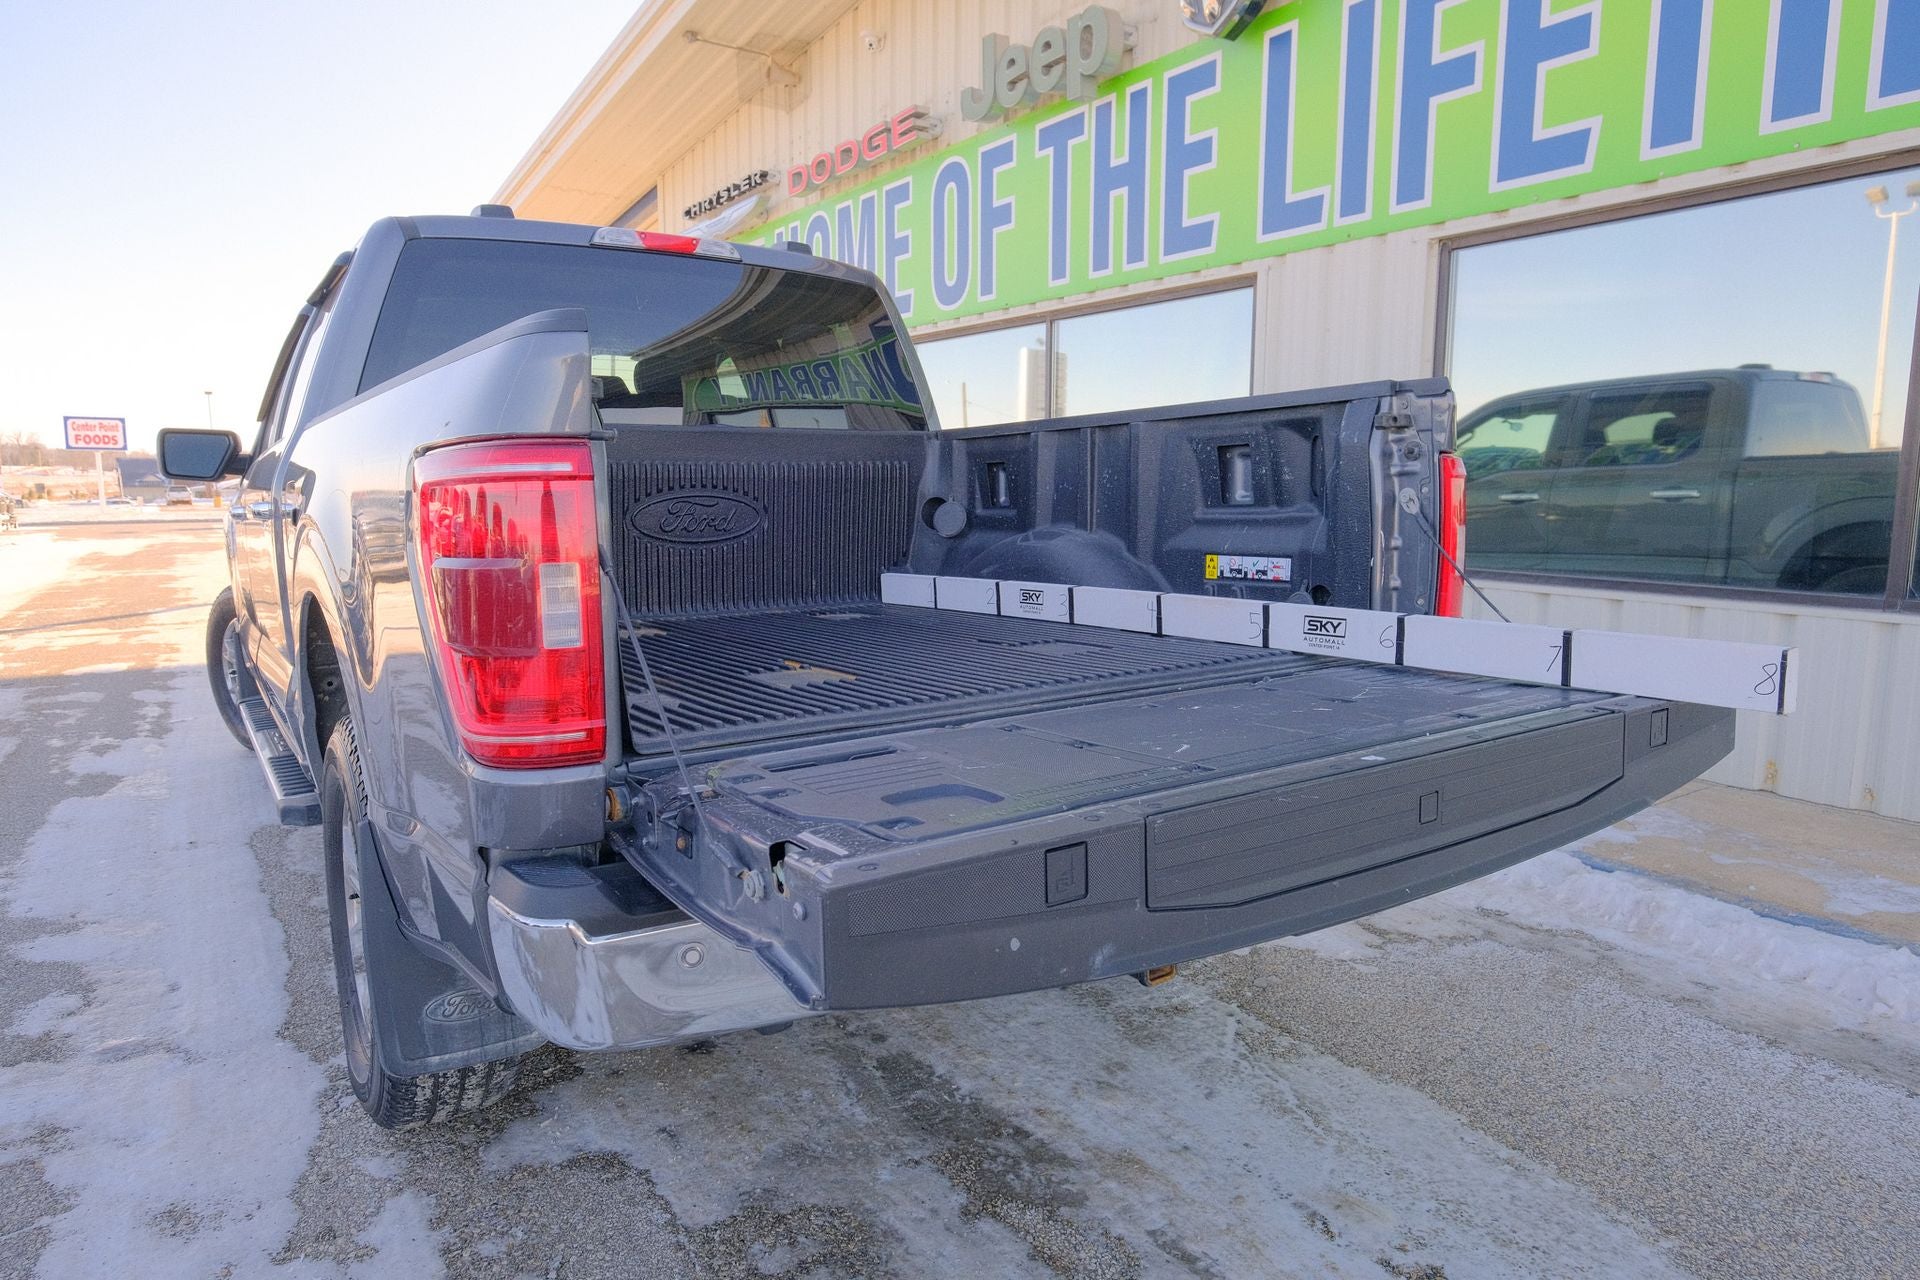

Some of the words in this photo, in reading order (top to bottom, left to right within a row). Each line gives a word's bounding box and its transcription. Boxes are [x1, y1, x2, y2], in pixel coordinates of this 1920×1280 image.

[960, 4, 1112, 122] Jeep
[786, 104, 927, 198] DODGE
[683, 169, 768, 219] CHRYSLER
[775, 179, 915, 318] ME
[931, 132, 1018, 312] OF
[1034, 49, 1223, 288] THE
[71, 421, 97, 432] Center
[98, 422, 120, 433] Point
[74, 434, 119, 446] FOODS
[660, 500, 738, 533] Ford
[985, 587, 996, 605] 2
[1021, 591, 1042, 602] SKY
[1058, 593, 1069, 617] 3
[1146, 600, 1158, 629] 4
[1248, 611, 1262, 640] 5
[1306, 619, 1342, 634] SKY
[1303, 636, 1345, 646] AUTOMALL
[1379, 625, 1395, 649] 6
[1546, 645, 1563, 673] 7
[1753, 662, 1779, 696] 8
